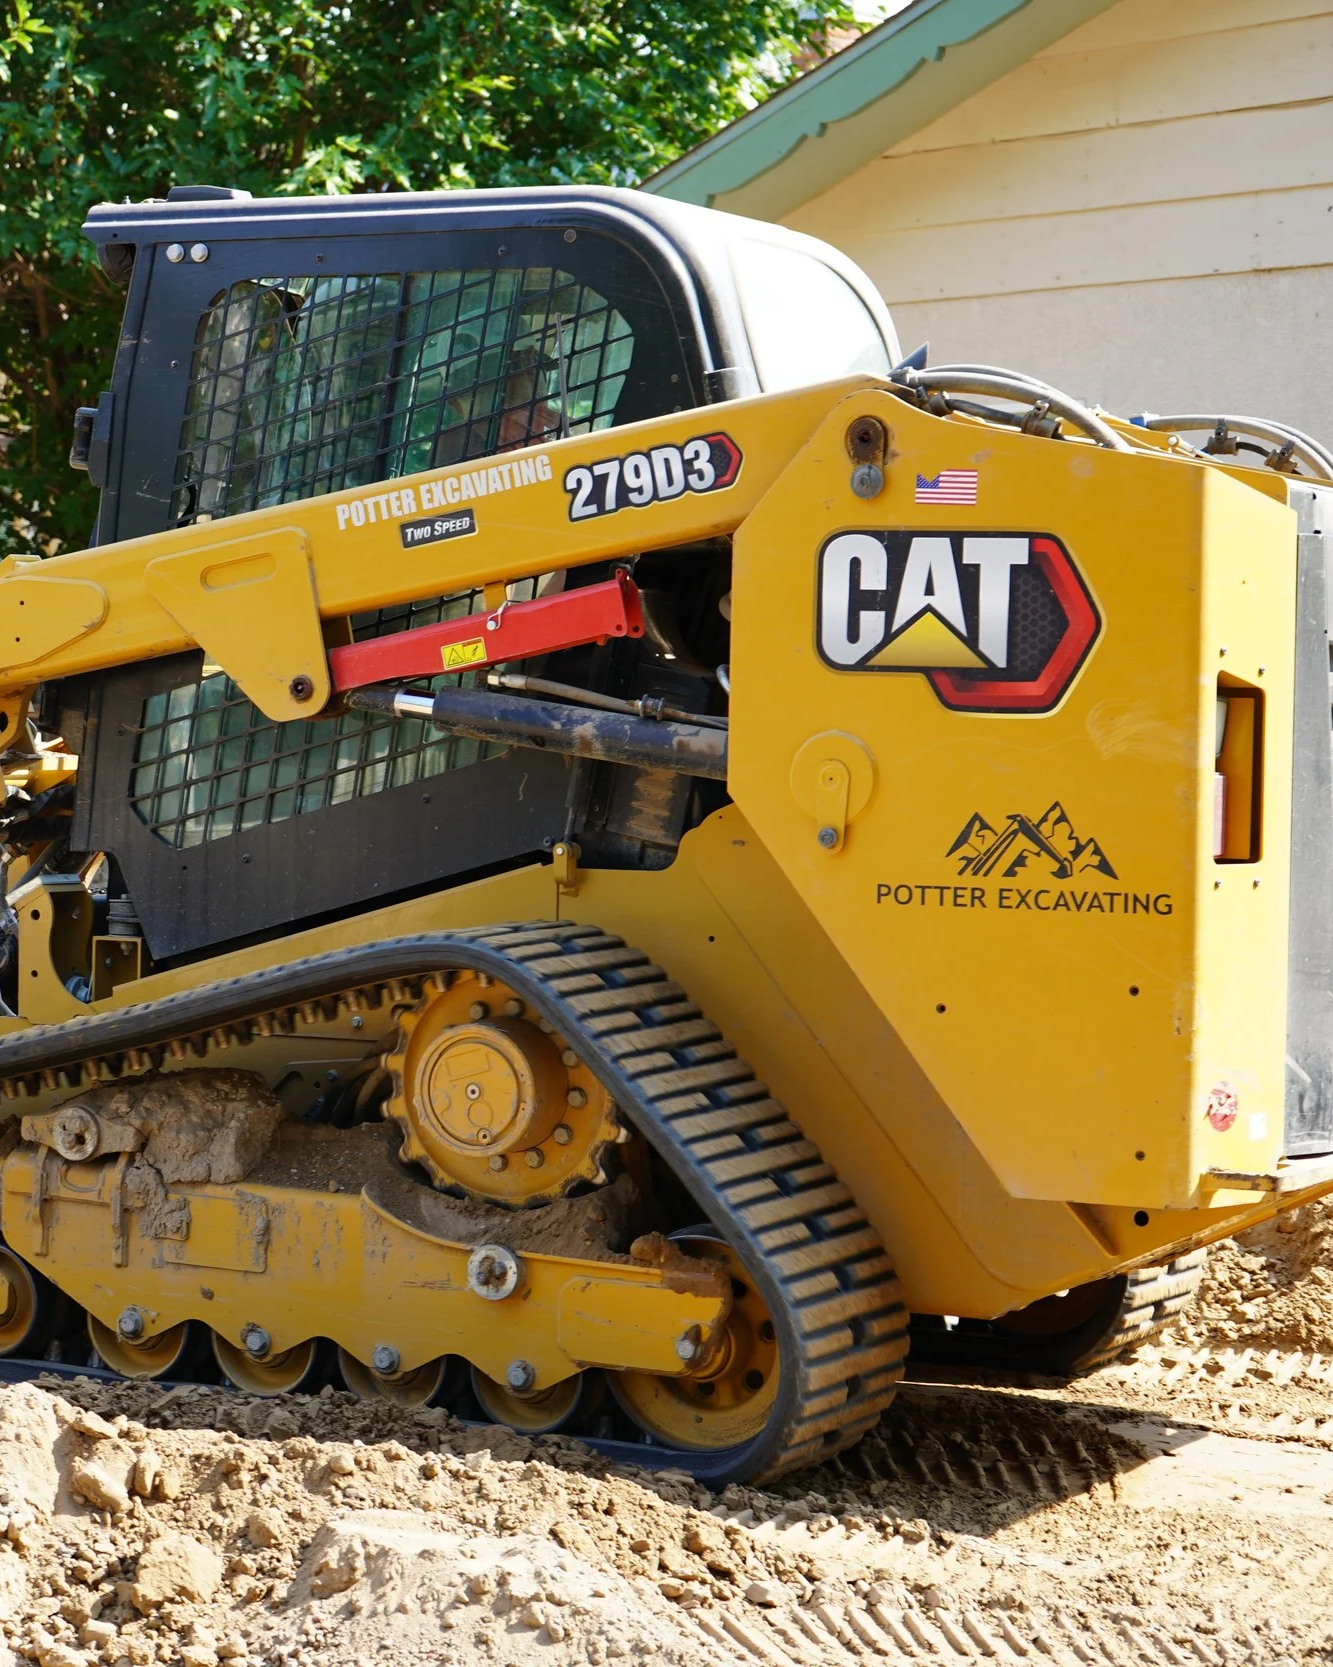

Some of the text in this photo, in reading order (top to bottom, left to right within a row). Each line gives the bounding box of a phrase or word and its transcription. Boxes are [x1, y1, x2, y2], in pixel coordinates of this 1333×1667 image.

[336, 455, 553, 531] POTTER EXCAVATING
[566, 439, 716, 519] 279D3
[821, 533, 1029, 669] CAT
[876, 883, 1173, 916] POTTER EXCAVATING
